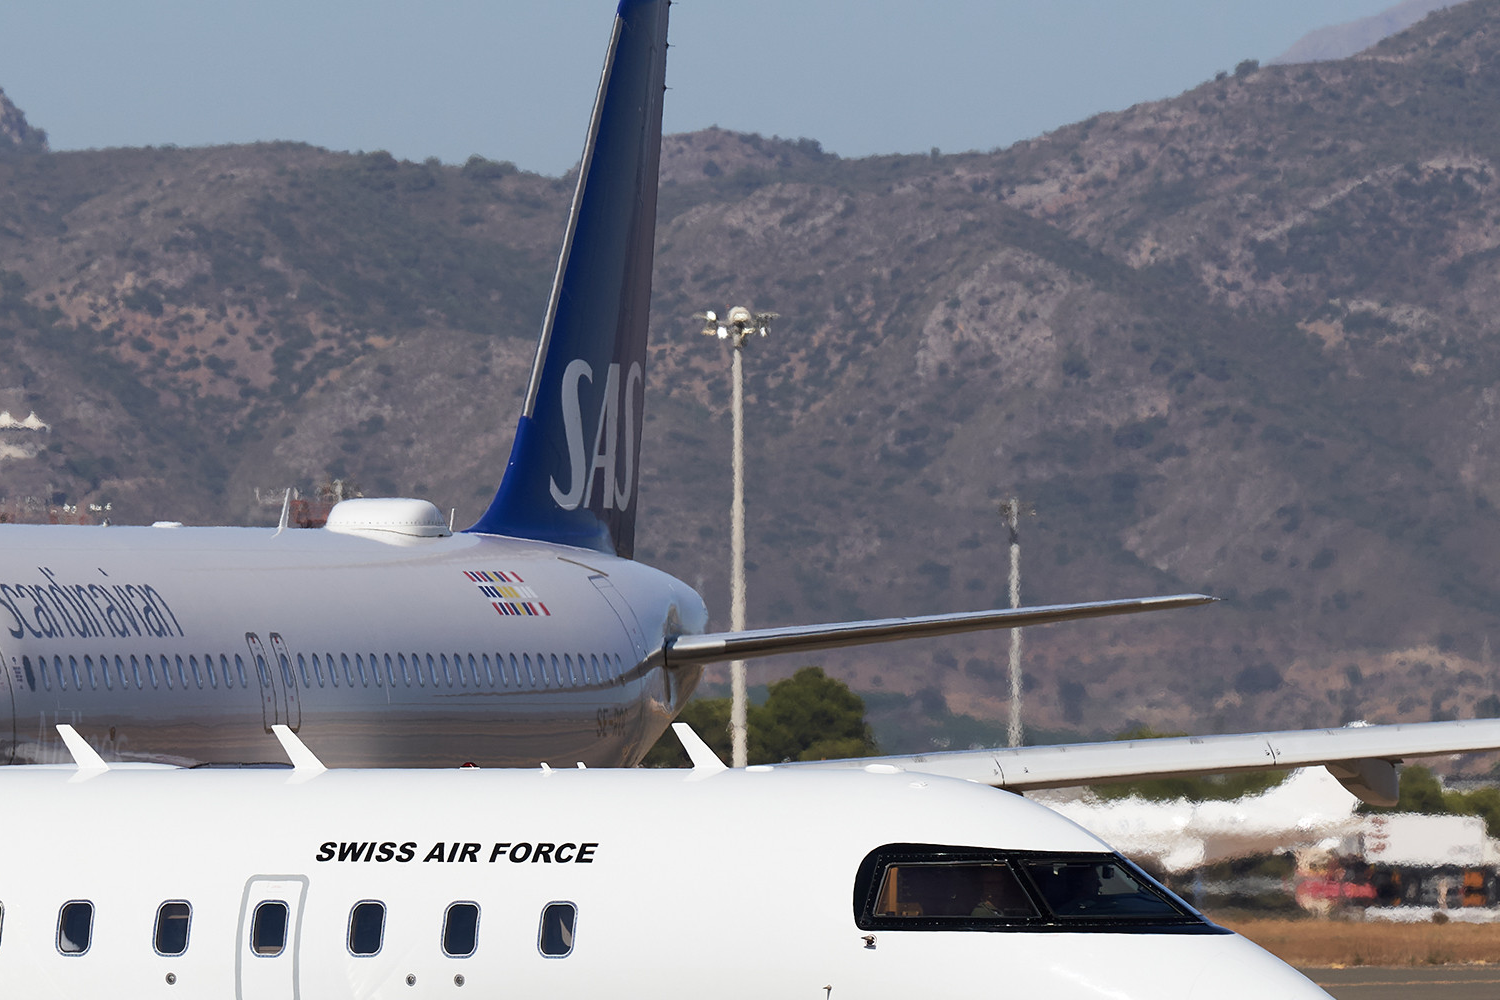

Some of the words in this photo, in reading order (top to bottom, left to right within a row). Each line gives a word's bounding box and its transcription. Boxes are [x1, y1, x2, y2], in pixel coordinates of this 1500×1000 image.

[550, 359, 642, 512] SAS
[315, 841, 418, 863] SWISS
[423, 842, 482, 863] AIR
[488, 842, 599, 864] FORCE
